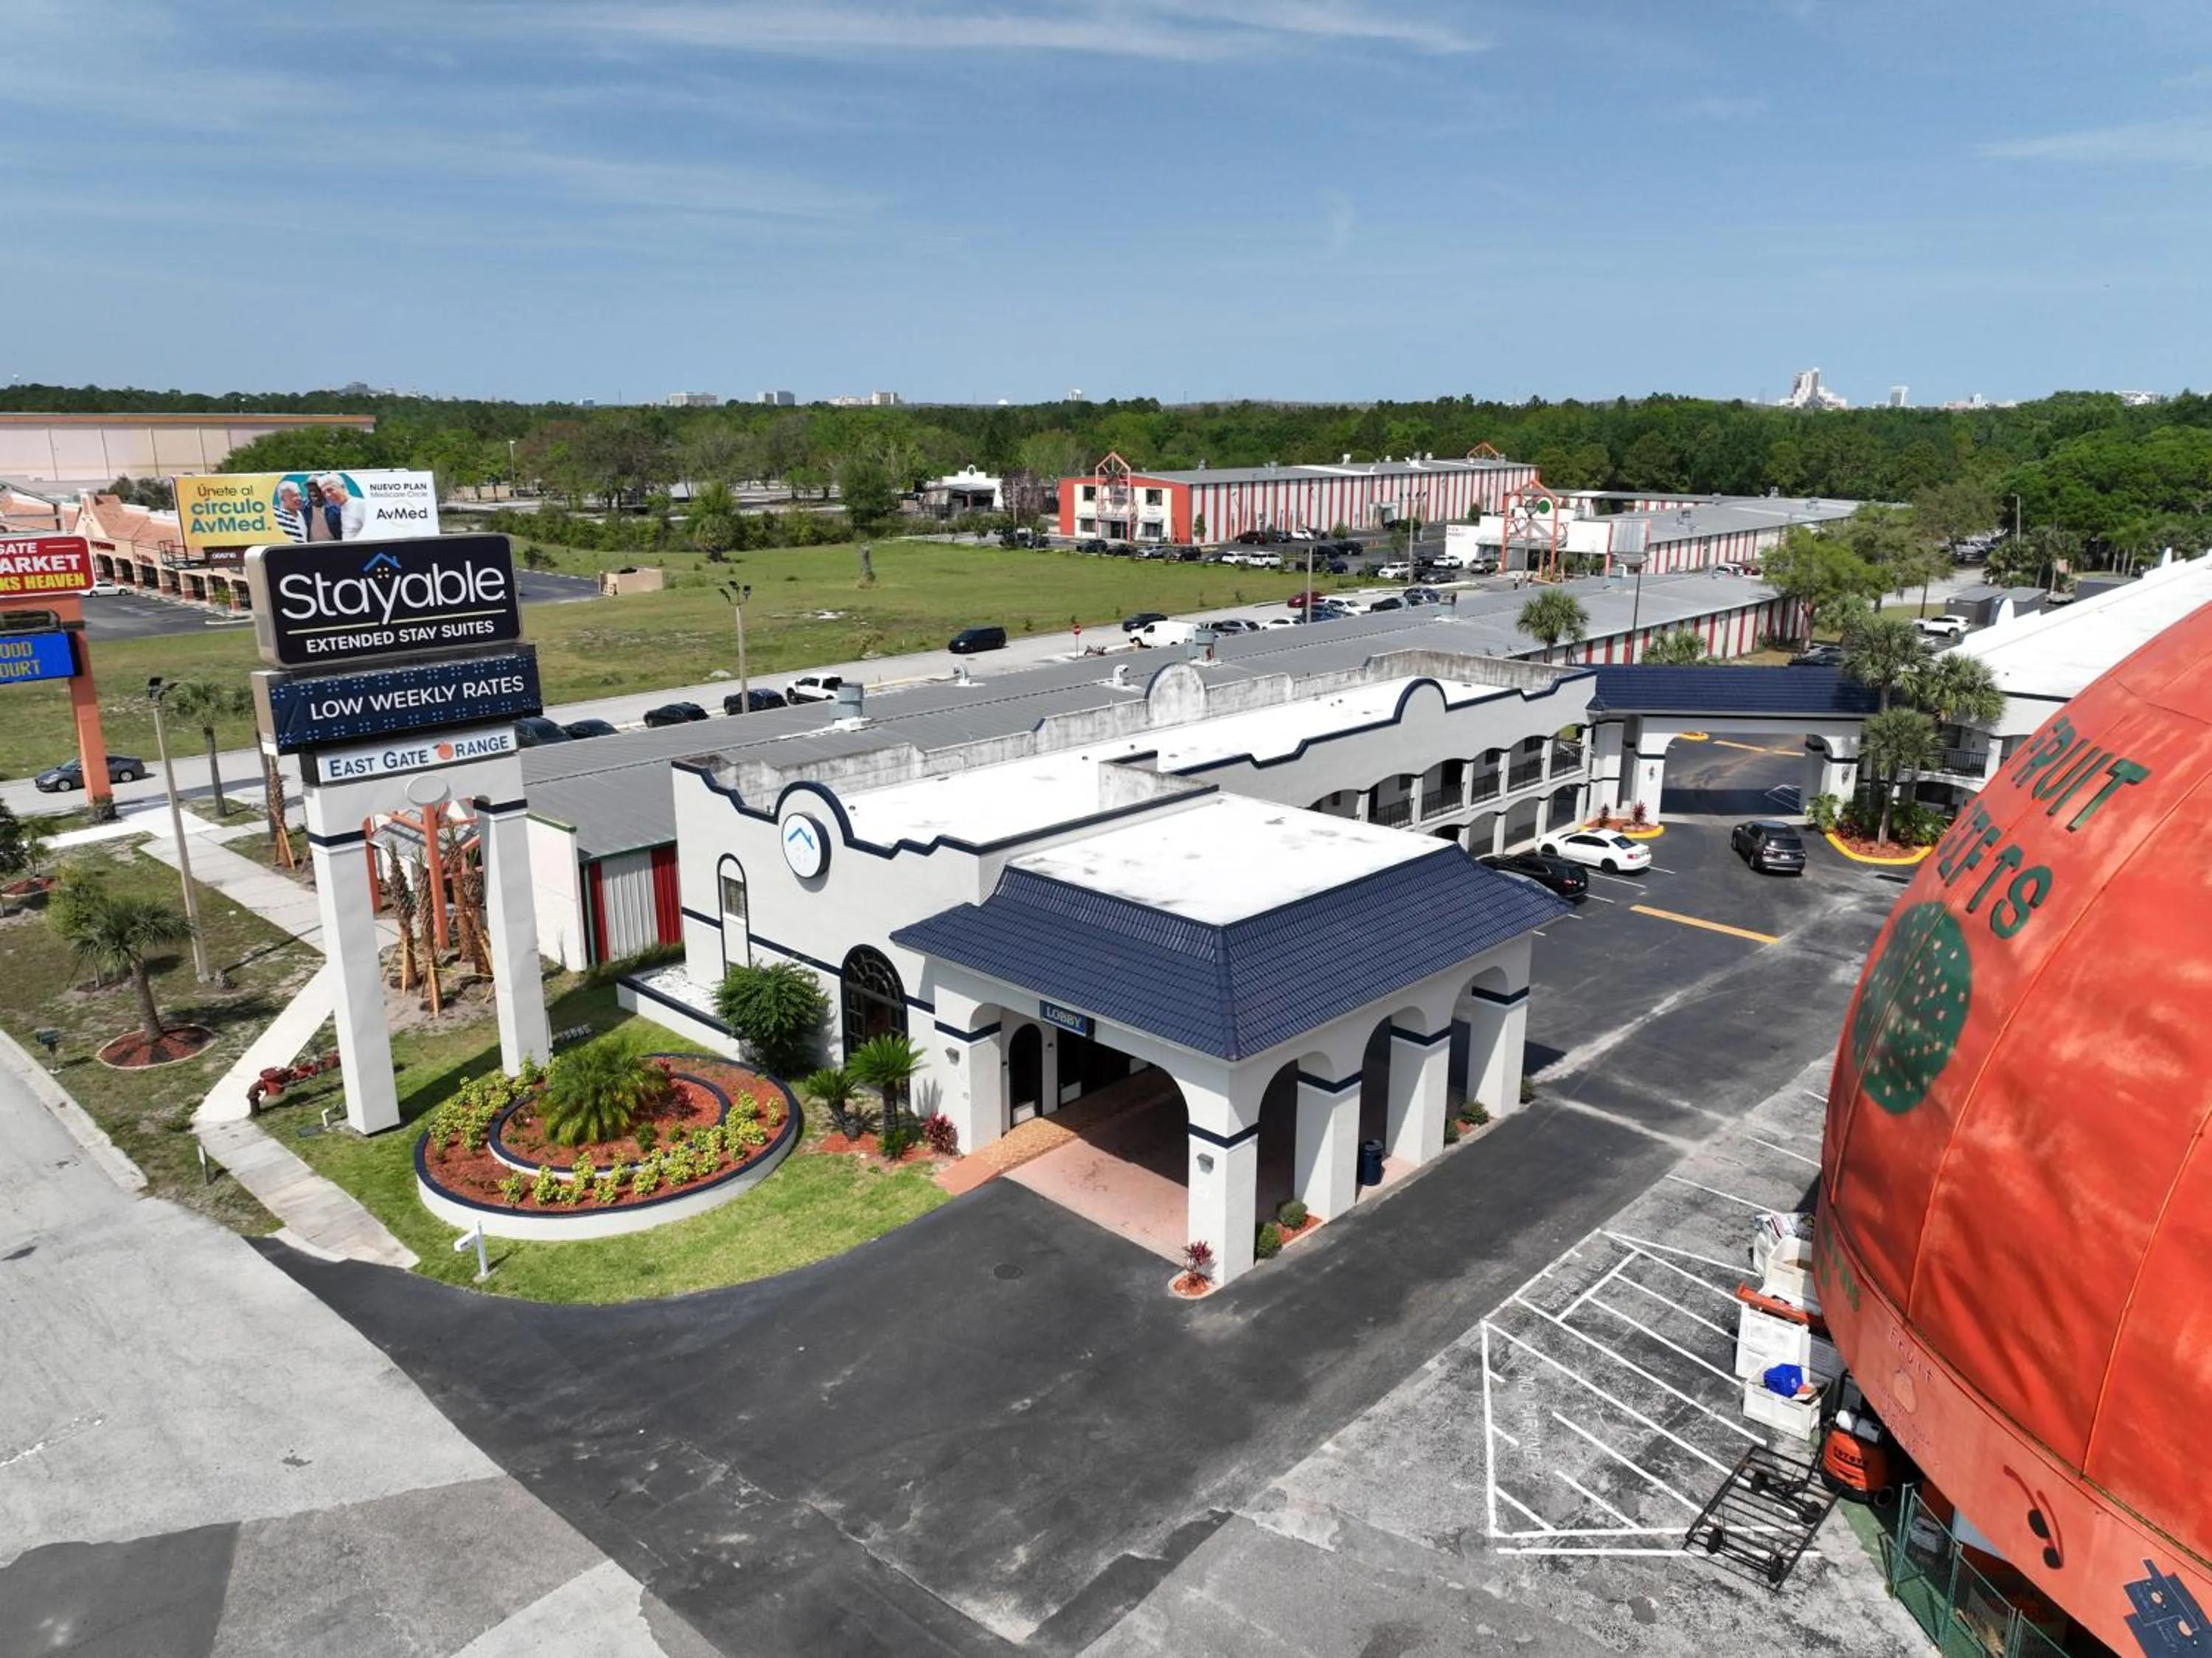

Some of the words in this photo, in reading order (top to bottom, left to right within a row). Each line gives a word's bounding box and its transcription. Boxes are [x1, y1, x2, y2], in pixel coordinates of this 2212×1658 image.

[198, 483, 237, 496] Únete
[241, 484, 253, 496] al
[369, 483, 401, 491] NUEVO
[403, 482, 427, 490] PLAN
[190, 497, 265, 516] círculo
[377, 507, 428, 519] AvMed
[190, 517, 271, 534] AvMed.
[24, 572, 86, 590] HEAVEN
[279, 561, 506, 625] Stayable
[306, 632, 395, 653] EXTENDED
[398, 626, 437, 643] STAY
[442, 620, 495, 638] SUITES
[310, 697, 364, 721] LOW
[369, 684, 456, 712] WEEKLY
[462, 675, 524, 698] RATES
[330, 757, 375, 777] EAST
[383, 749, 428, 769] GATE
[2009, 715, 2152, 833] FRUIT
[1047, 1006, 1082, 1028] LOBBY
